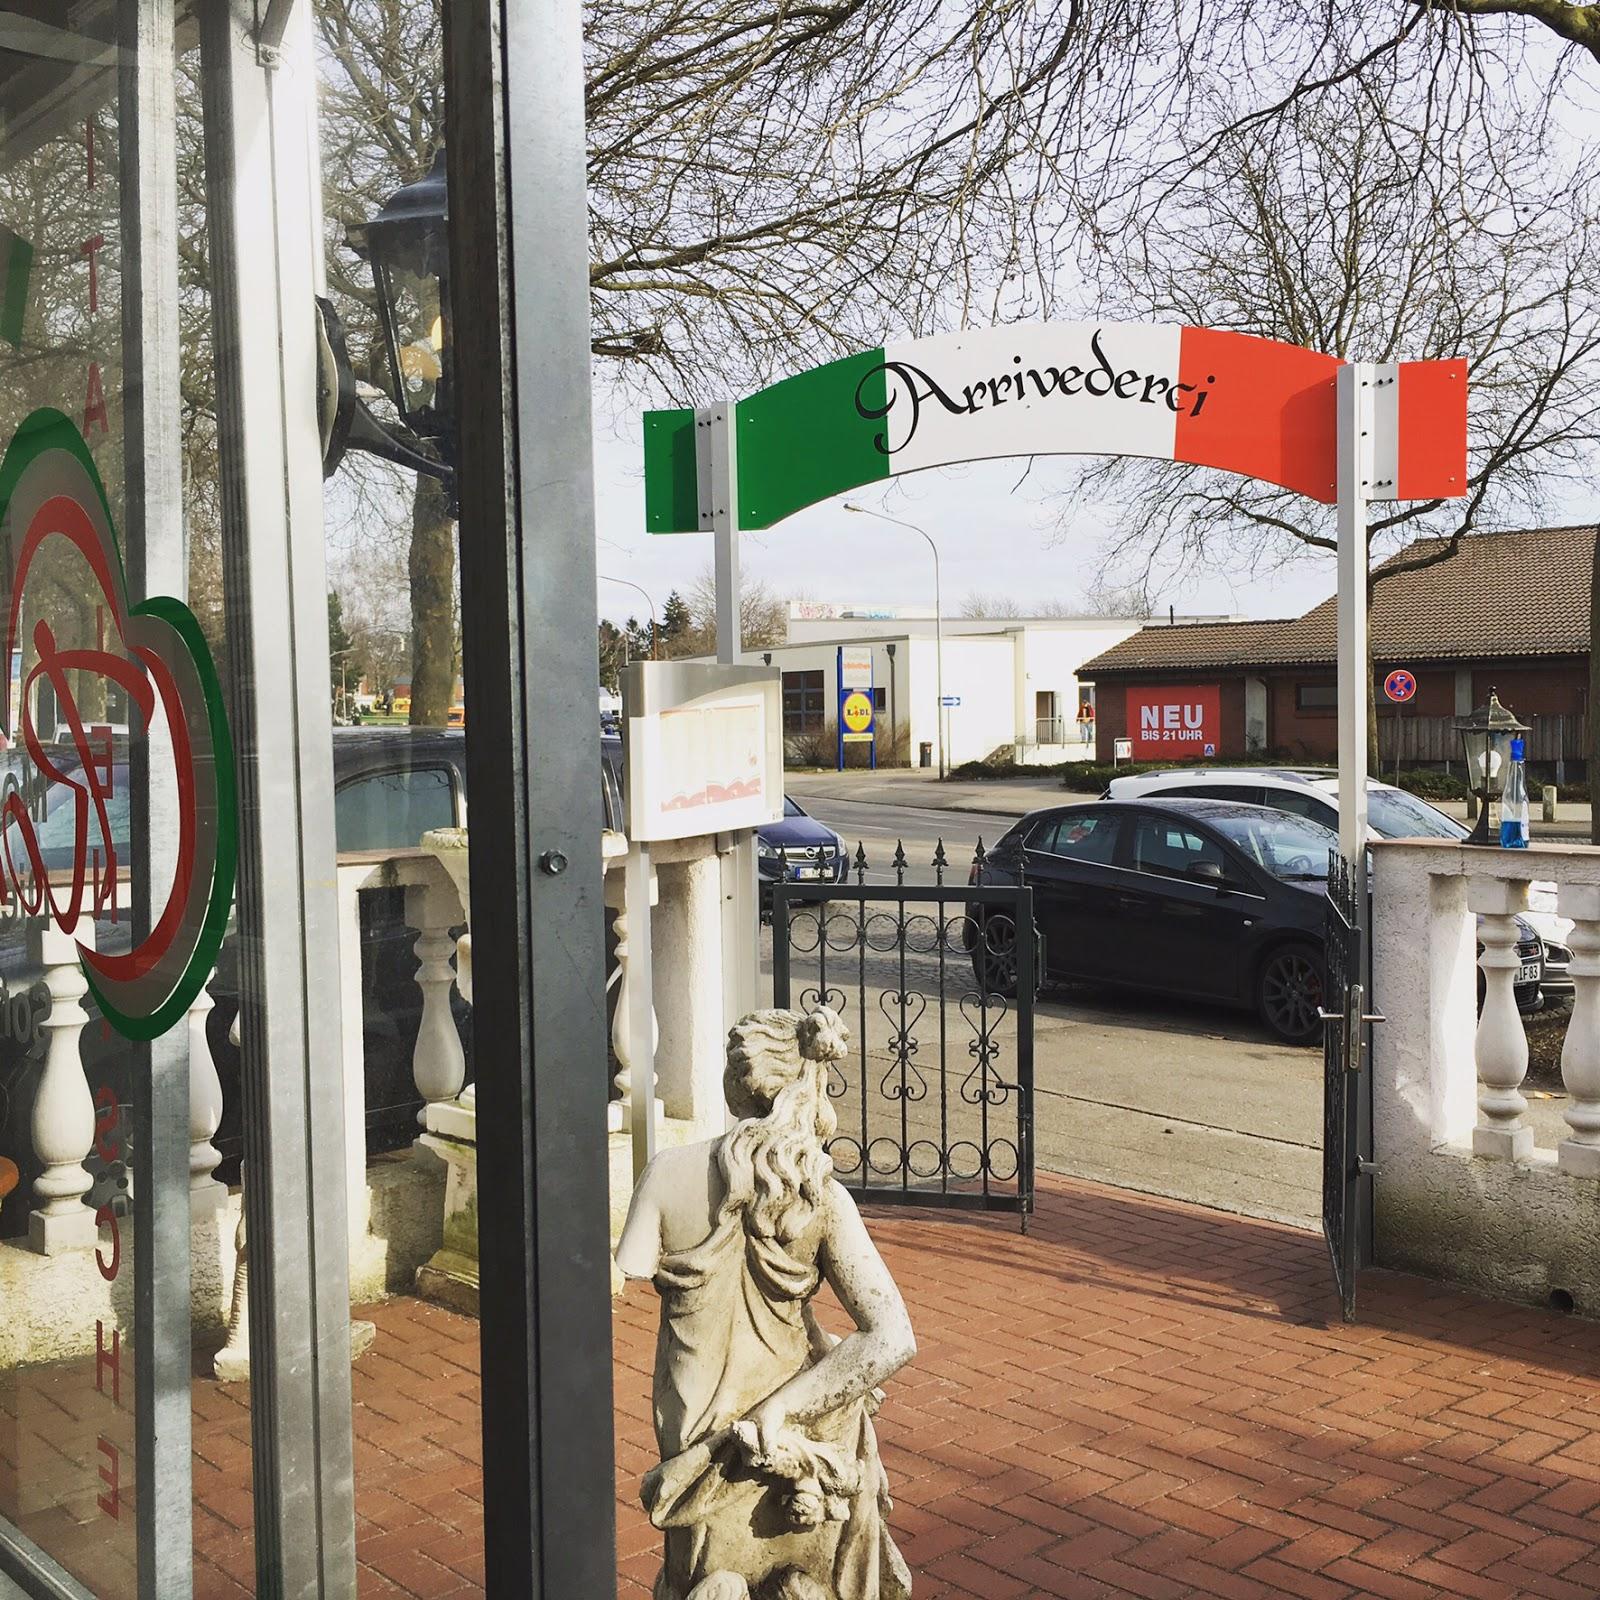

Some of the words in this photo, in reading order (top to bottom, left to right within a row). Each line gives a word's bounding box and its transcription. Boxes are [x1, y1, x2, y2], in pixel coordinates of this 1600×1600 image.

[855, 328, 1215, 455] Arrivederci
[1141, 705, 1203, 729] NEU
[1142, 731, 1160, 741] BIS
[1163, 731, 1176, 741] 21
[1178, 730, 1203, 740] UHR
